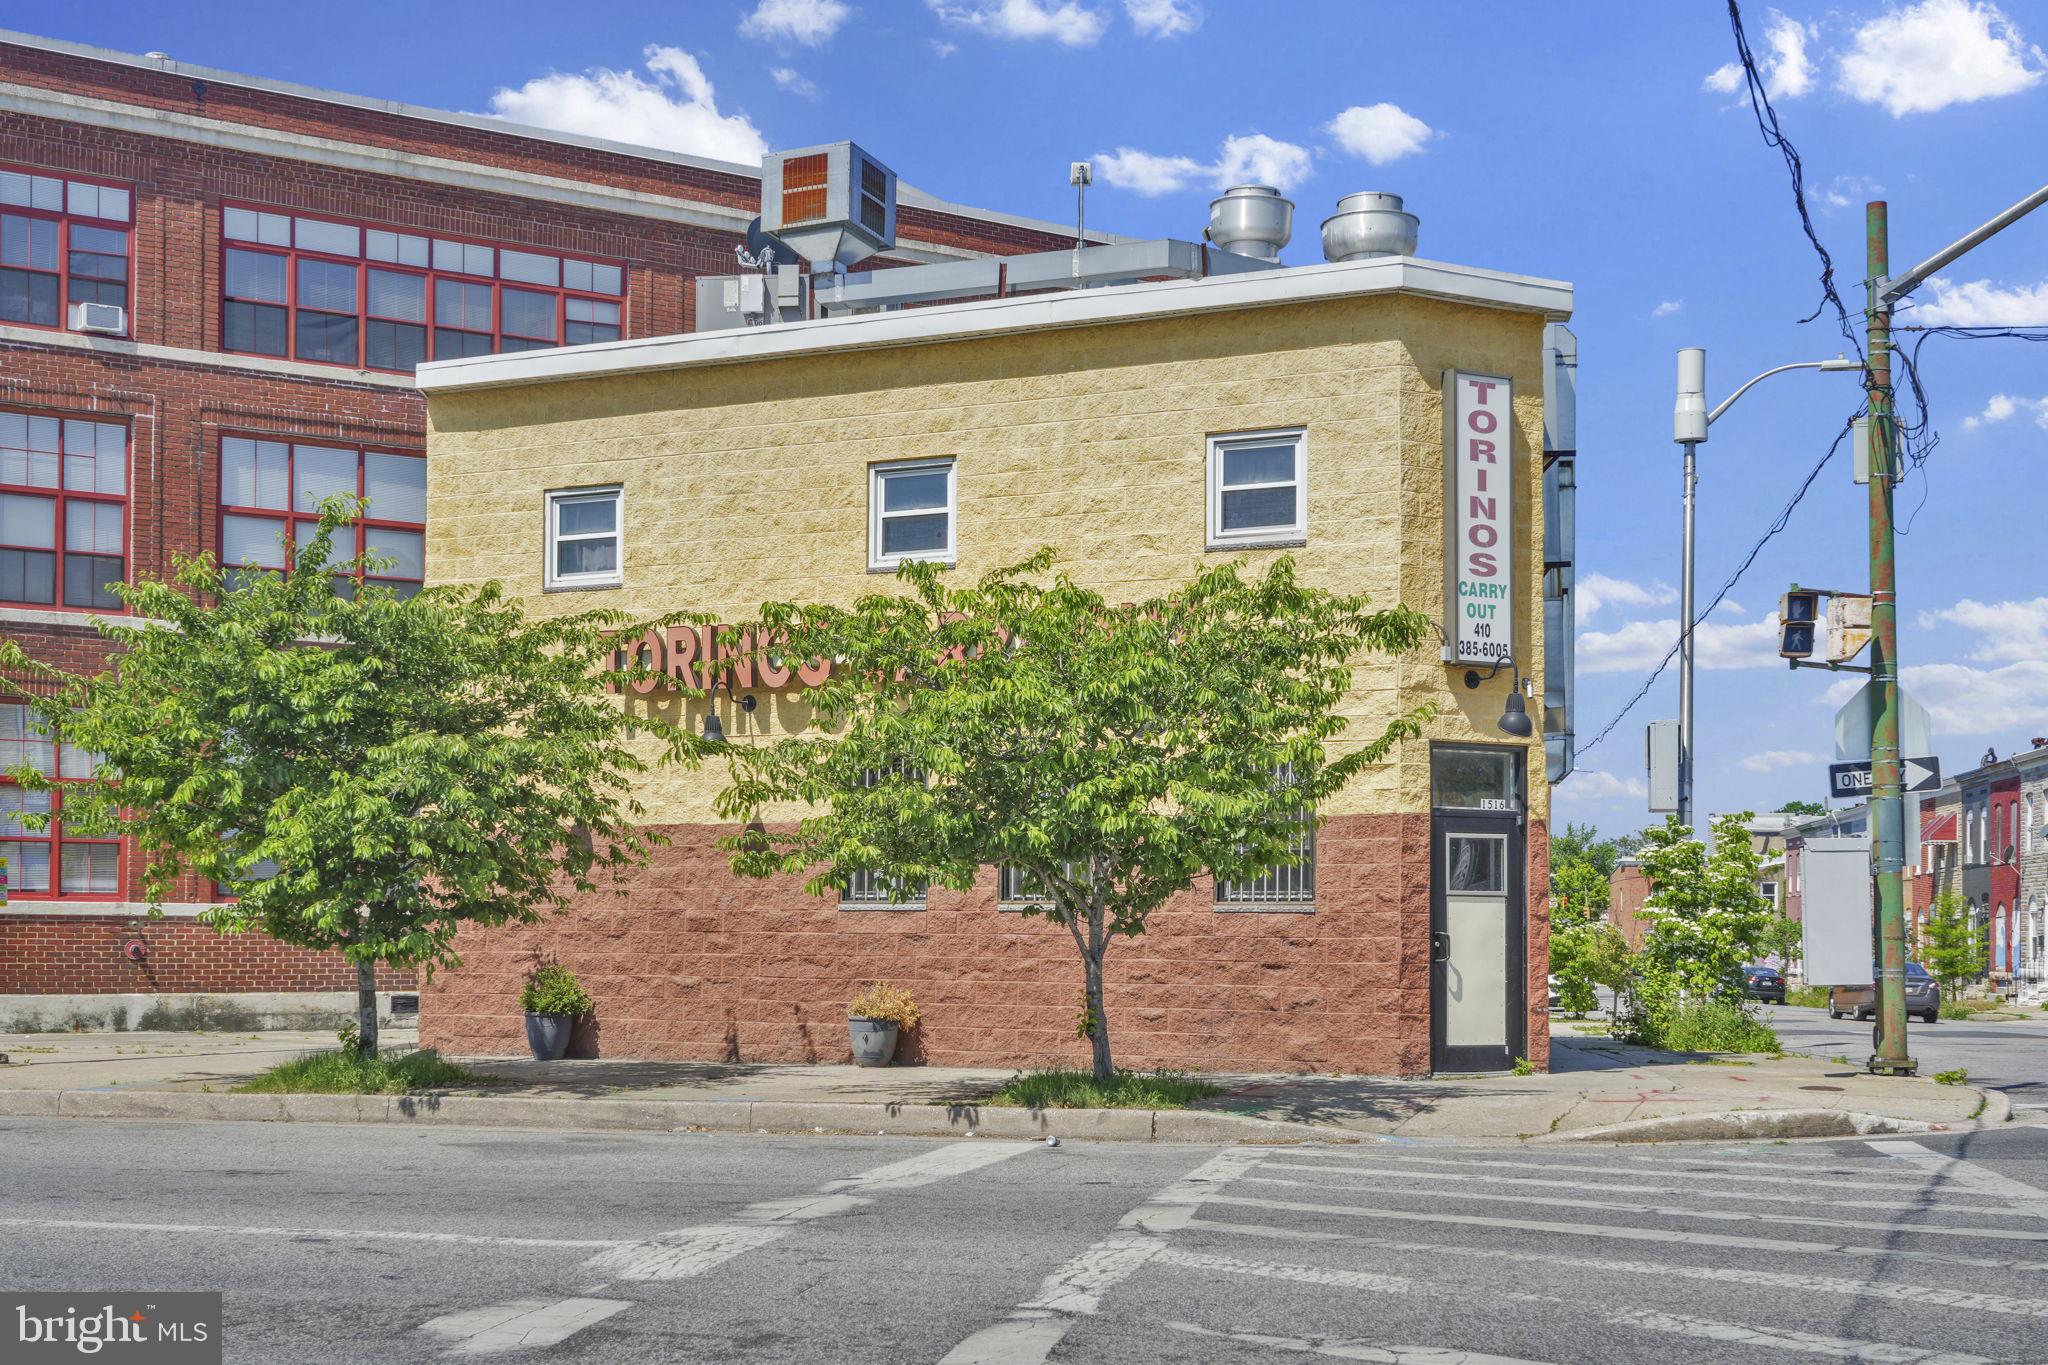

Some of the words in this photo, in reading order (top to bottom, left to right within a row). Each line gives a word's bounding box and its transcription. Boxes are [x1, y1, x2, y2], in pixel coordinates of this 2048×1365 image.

[1468, 380, 1498, 577] TORINOS
[1458, 580, 1508, 600] CARRY
[1467, 603, 1497, 619] OUT
[1474, 623, 1491, 638] 410
[1841, 771, 1872, 787] ONE
[1482, 799, 1505, 810] 1516
